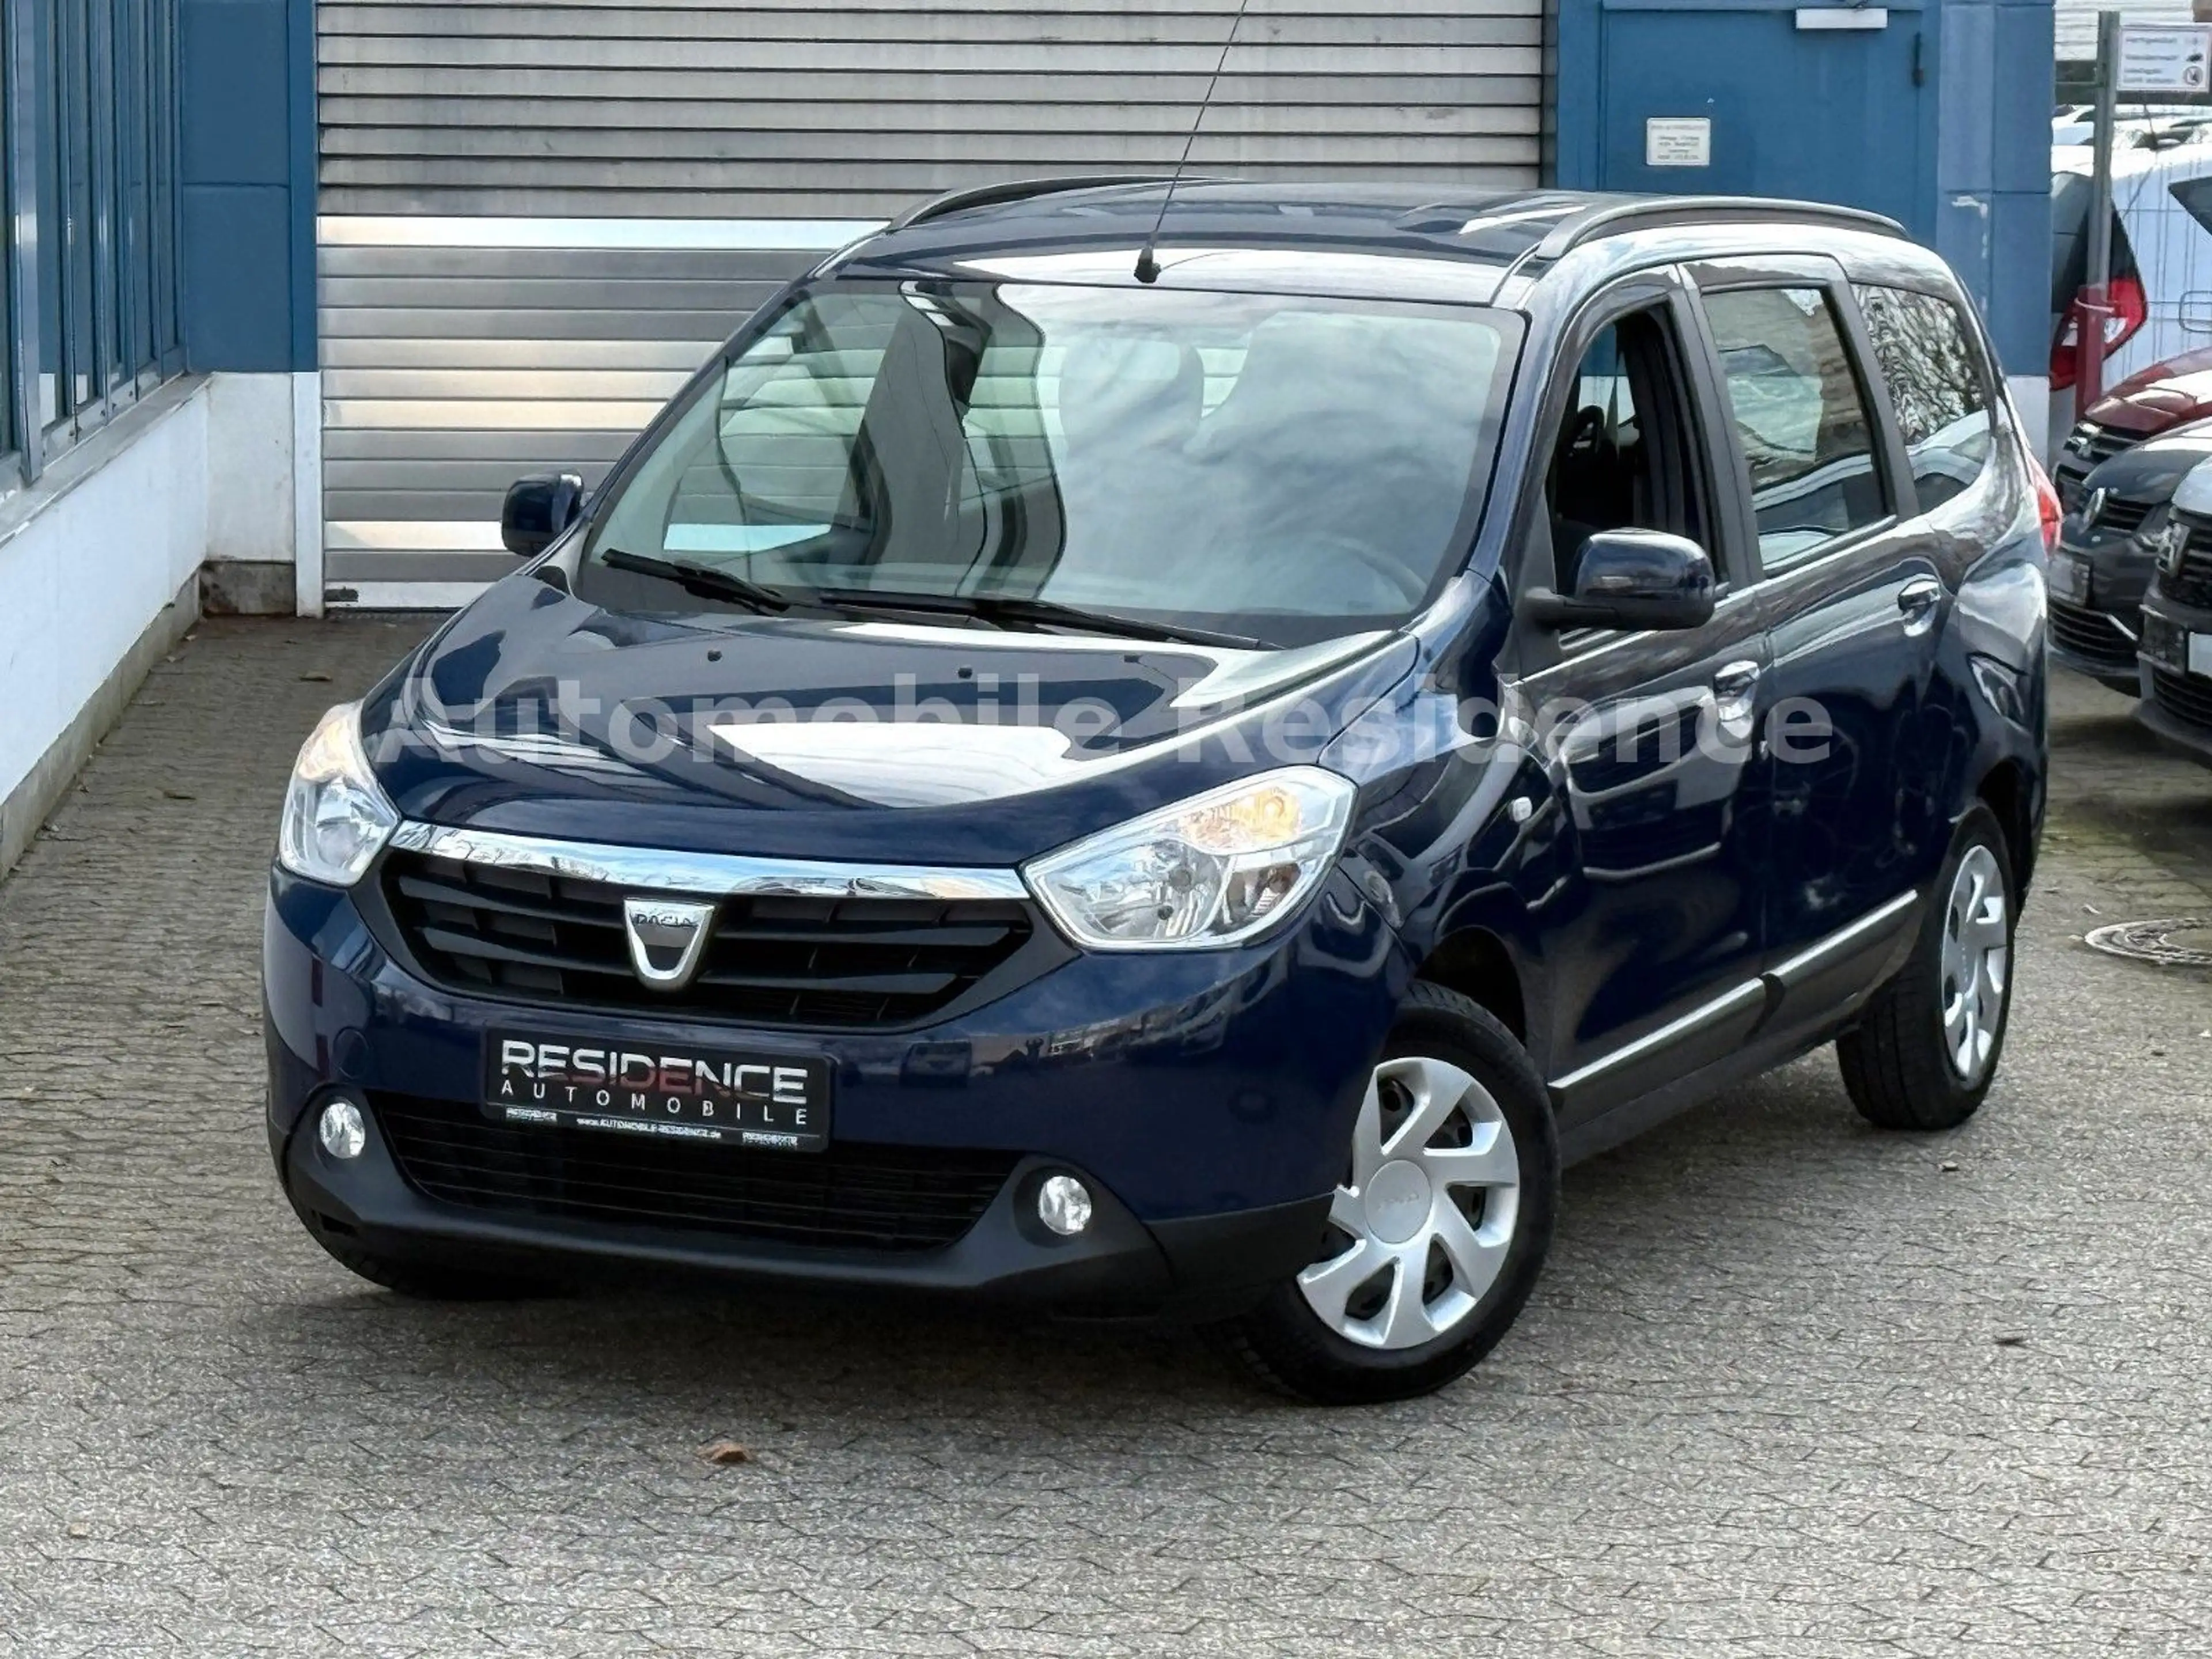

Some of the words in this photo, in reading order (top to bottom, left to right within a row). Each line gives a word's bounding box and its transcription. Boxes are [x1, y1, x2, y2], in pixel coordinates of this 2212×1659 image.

[635, 912, 698, 928] DACIA
[501, 1039, 808, 1104] RESIDENCE
[501, 1080, 808, 1126] AUTOMOBILE
